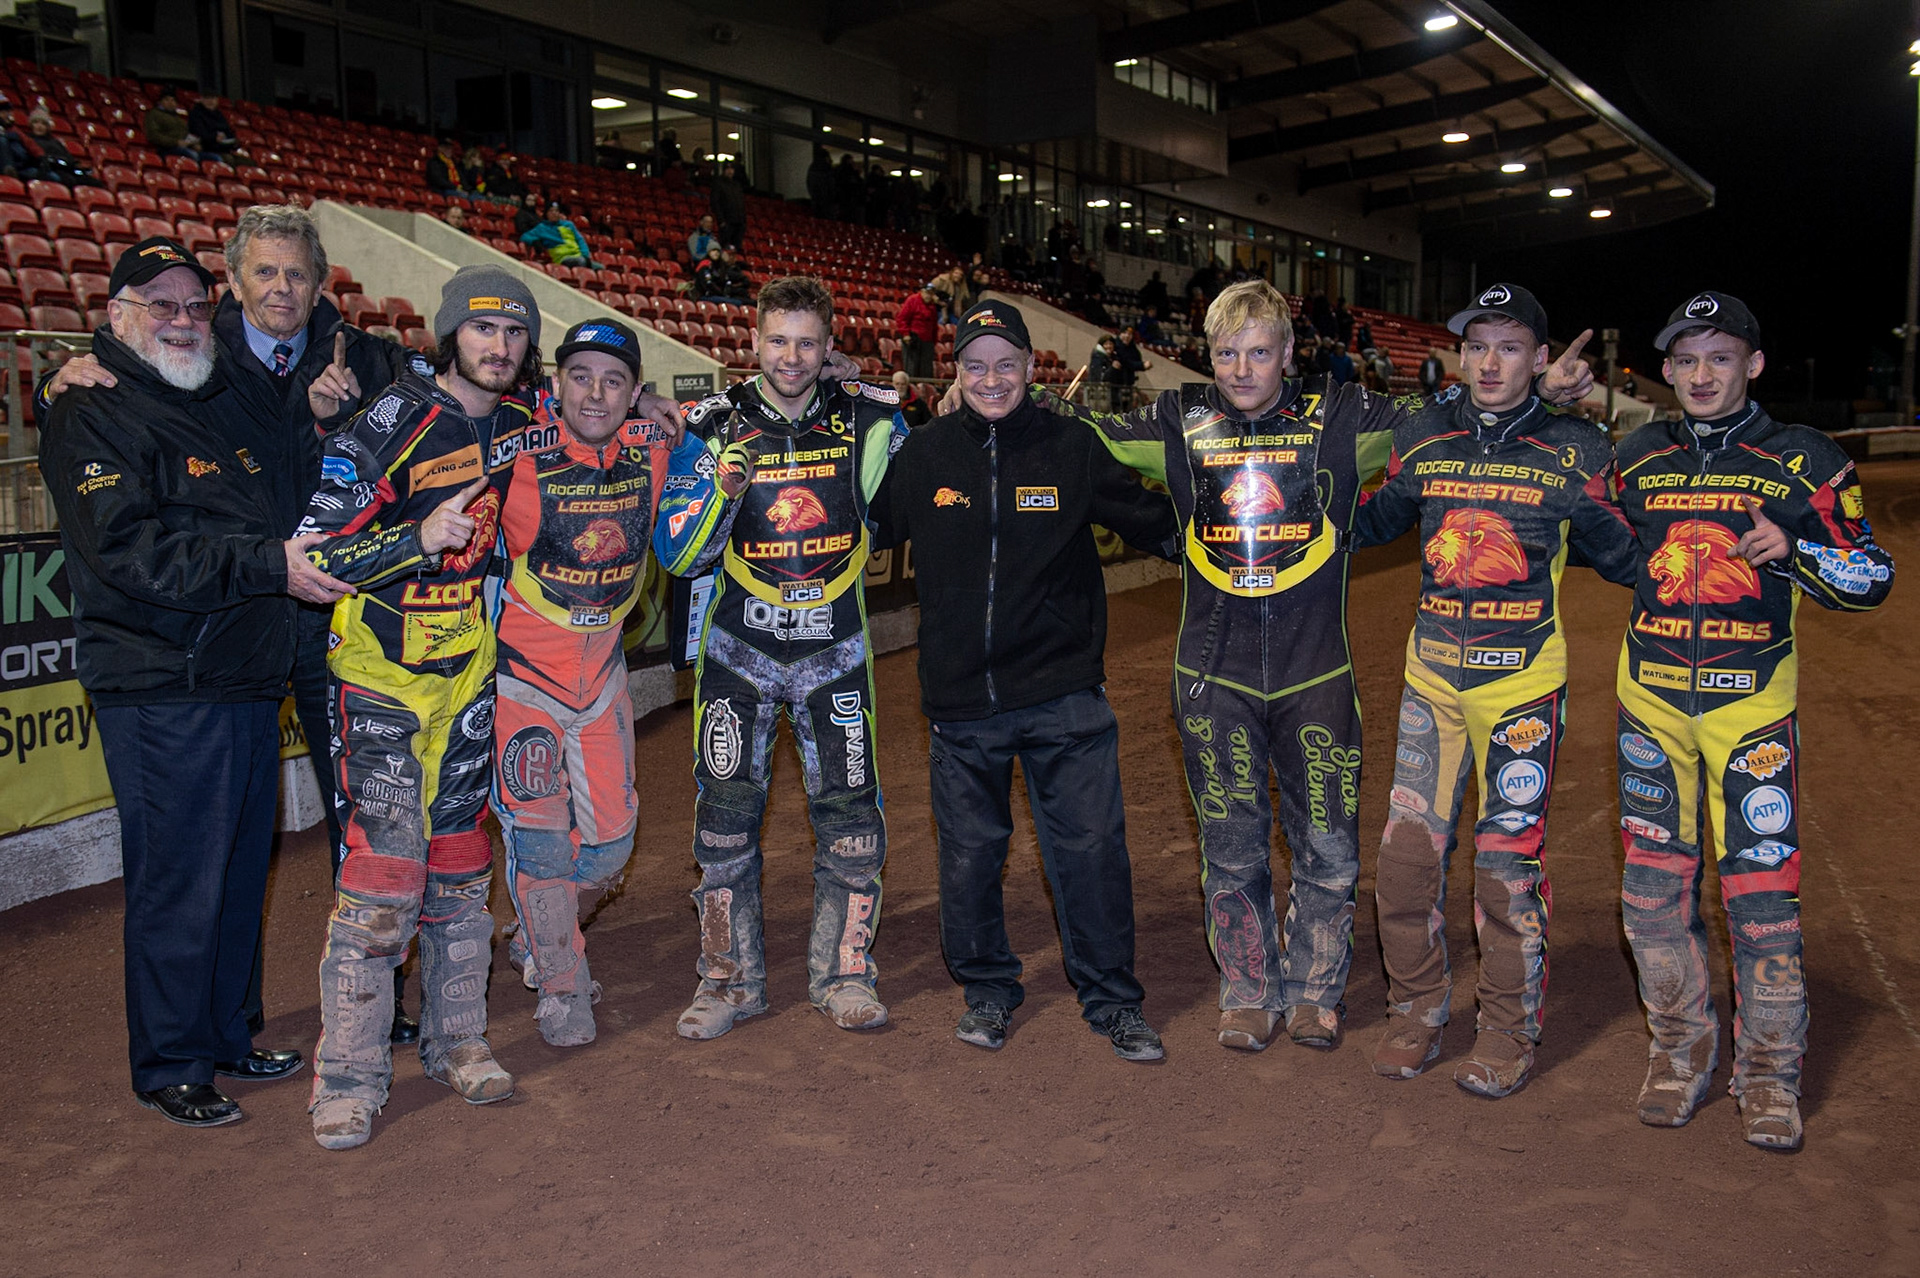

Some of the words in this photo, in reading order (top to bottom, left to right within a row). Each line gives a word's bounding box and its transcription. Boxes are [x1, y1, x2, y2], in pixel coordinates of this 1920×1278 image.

[1689, 301, 1712, 312] ATPI
[1301, 394, 1322, 417] 7
[830, 414, 845, 434] 5
[1193, 437, 1240, 450] ROGER
[1243, 433, 1313, 447] WEBSTER
[629, 446, 643, 463] 6
[783, 446, 849, 463] WEBSTER
[1203, 450, 1298, 467] LEICESTER
[1561, 447, 1576, 468] 3
[1786, 454, 1805, 474] 4
[87, 473, 121, 484] Chapman
[104, 479, 116, 487] Ltd
[1415, 459, 1465, 475] ROGER
[1469, 462, 1567, 489] WEBSTER
[547, 483, 595, 496] ROGER
[599, 475, 648, 496] WEBSTER
[1422, 480, 1544, 506] LEICESTER
[1638, 473, 1687, 490] ROGER
[1690, 473, 1791, 500] WEBSTER
[558, 494, 640, 514] LEICESTER
[1020, 495, 1055, 507] JCB
[1203, 524, 1249, 542] LION
[1255, 522, 1312, 541] CUBS
[355, 543, 381, 559] Sons
[743, 540, 797, 559] LION
[802, 533, 852, 556] CUBS
[539, 562, 597, 584] LION
[1232, 567, 1274, 575] WATLING
[1233, 574, 1273, 587] JCB
[782, 581, 823, 590] WATLING
[784, 588, 823, 601] JCB
[572, 606, 612, 614] WATLING
[1420, 593, 1463, 619] LION
[1469, 599, 1544, 620] CUBS
[571, 613, 610, 626] JCB
[1634, 610, 1693, 639] LION
[1701, 620, 1773, 641] CUBS
[1467, 651, 1521, 665] JCB
[1642, 668, 1675, 682] WATLING
[1700, 674, 1752, 689] JCB
[1184, 714, 1216, 745] &
[503, 739, 527, 798] STAKEFORD
[525, 743, 547, 793] STS
[1297, 722, 1338, 835] Coleman
[1506, 775, 1537, 790] ATPI
[1625, 775, 1665, 799] gbm
[1752, 800, 1783, 821] ATPI
[1624, 817, 1666, 841] BELL
